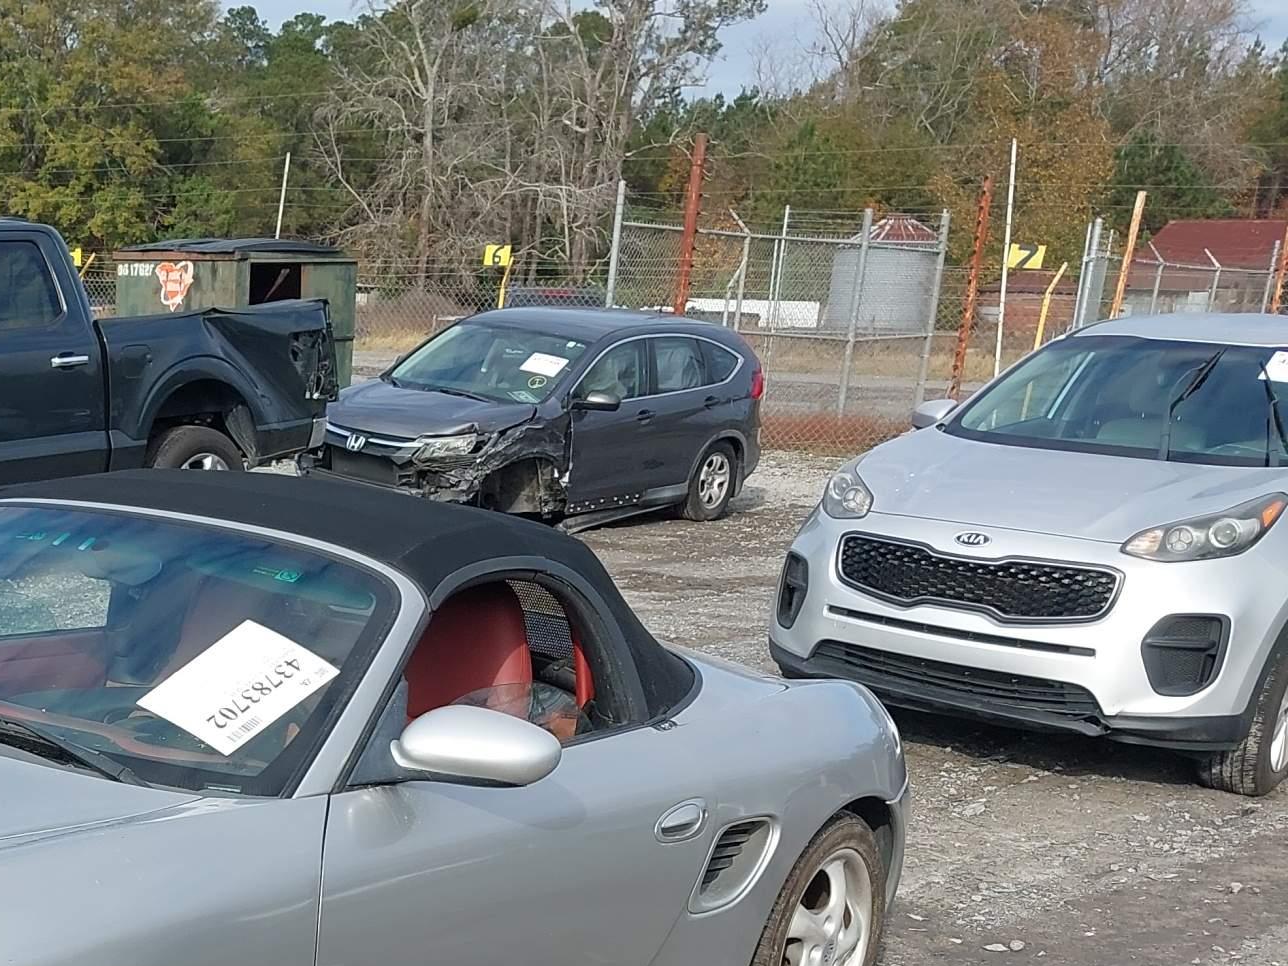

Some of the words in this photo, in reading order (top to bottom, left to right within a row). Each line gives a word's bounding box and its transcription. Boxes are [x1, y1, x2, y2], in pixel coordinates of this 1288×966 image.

[492, 245, 505, 266] 6
[1015, 241, 1040, 269] 7
[206, 658, 302, 729] 43783702
